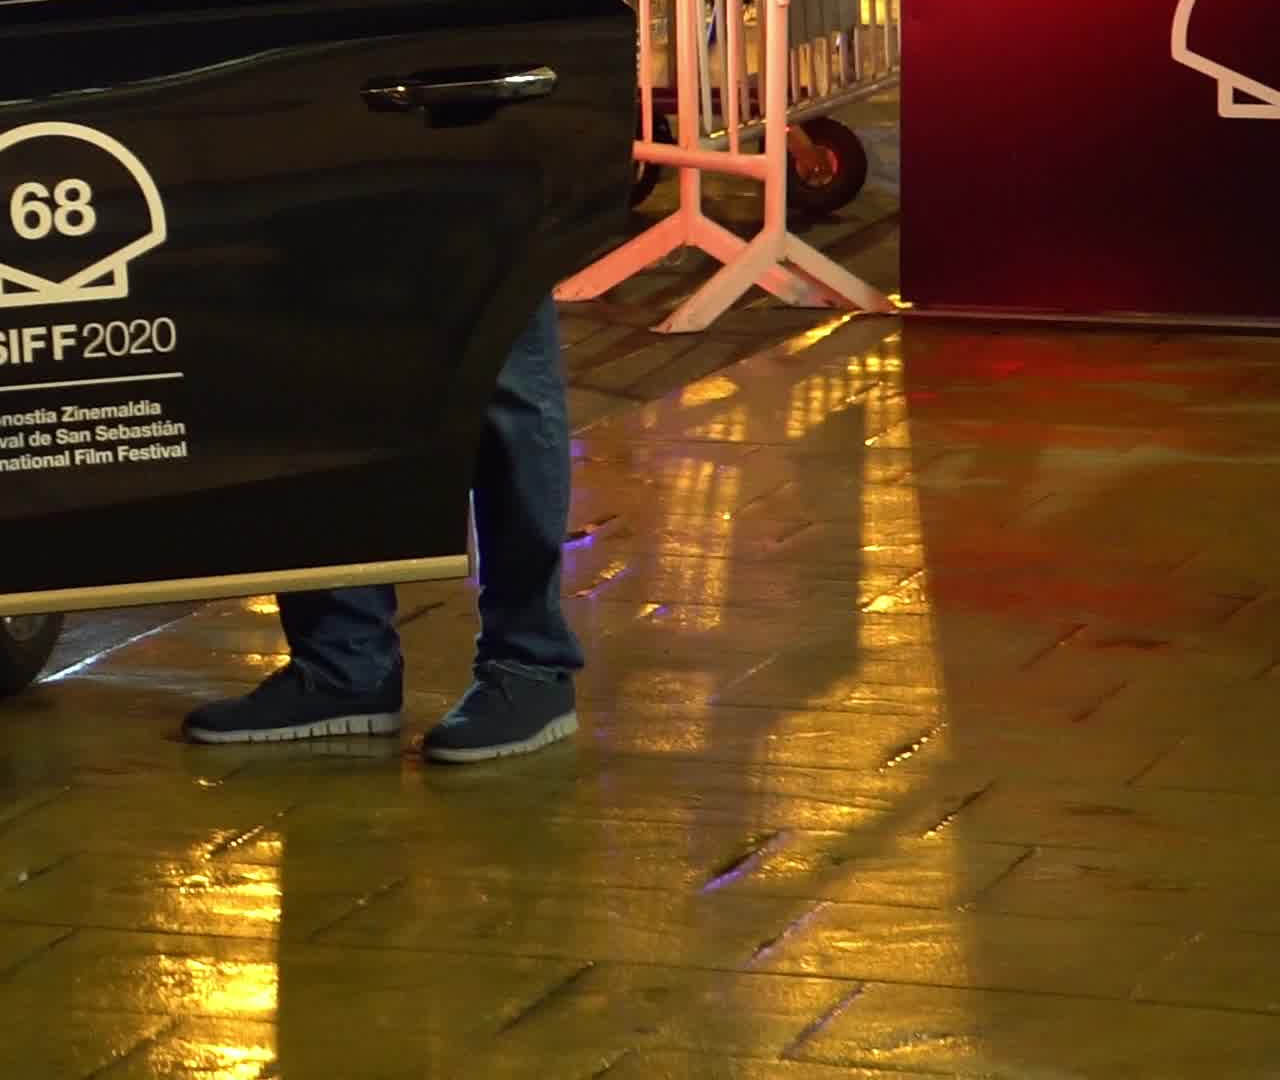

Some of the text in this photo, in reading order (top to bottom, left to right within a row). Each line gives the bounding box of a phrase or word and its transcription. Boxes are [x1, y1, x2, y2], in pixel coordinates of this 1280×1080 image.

[9, 177, 98, 240] 68
[81, 316, 178, 359] 2020
[60, 399, 162, 422] Zinemaldia
[28, 429, 52, 447] de
[55, 427, 92, 445] San
[95, 419, 186, 442] Sebastián
[74, 447, 114, 466] Film
[117, 440, 188, 462] Festival
